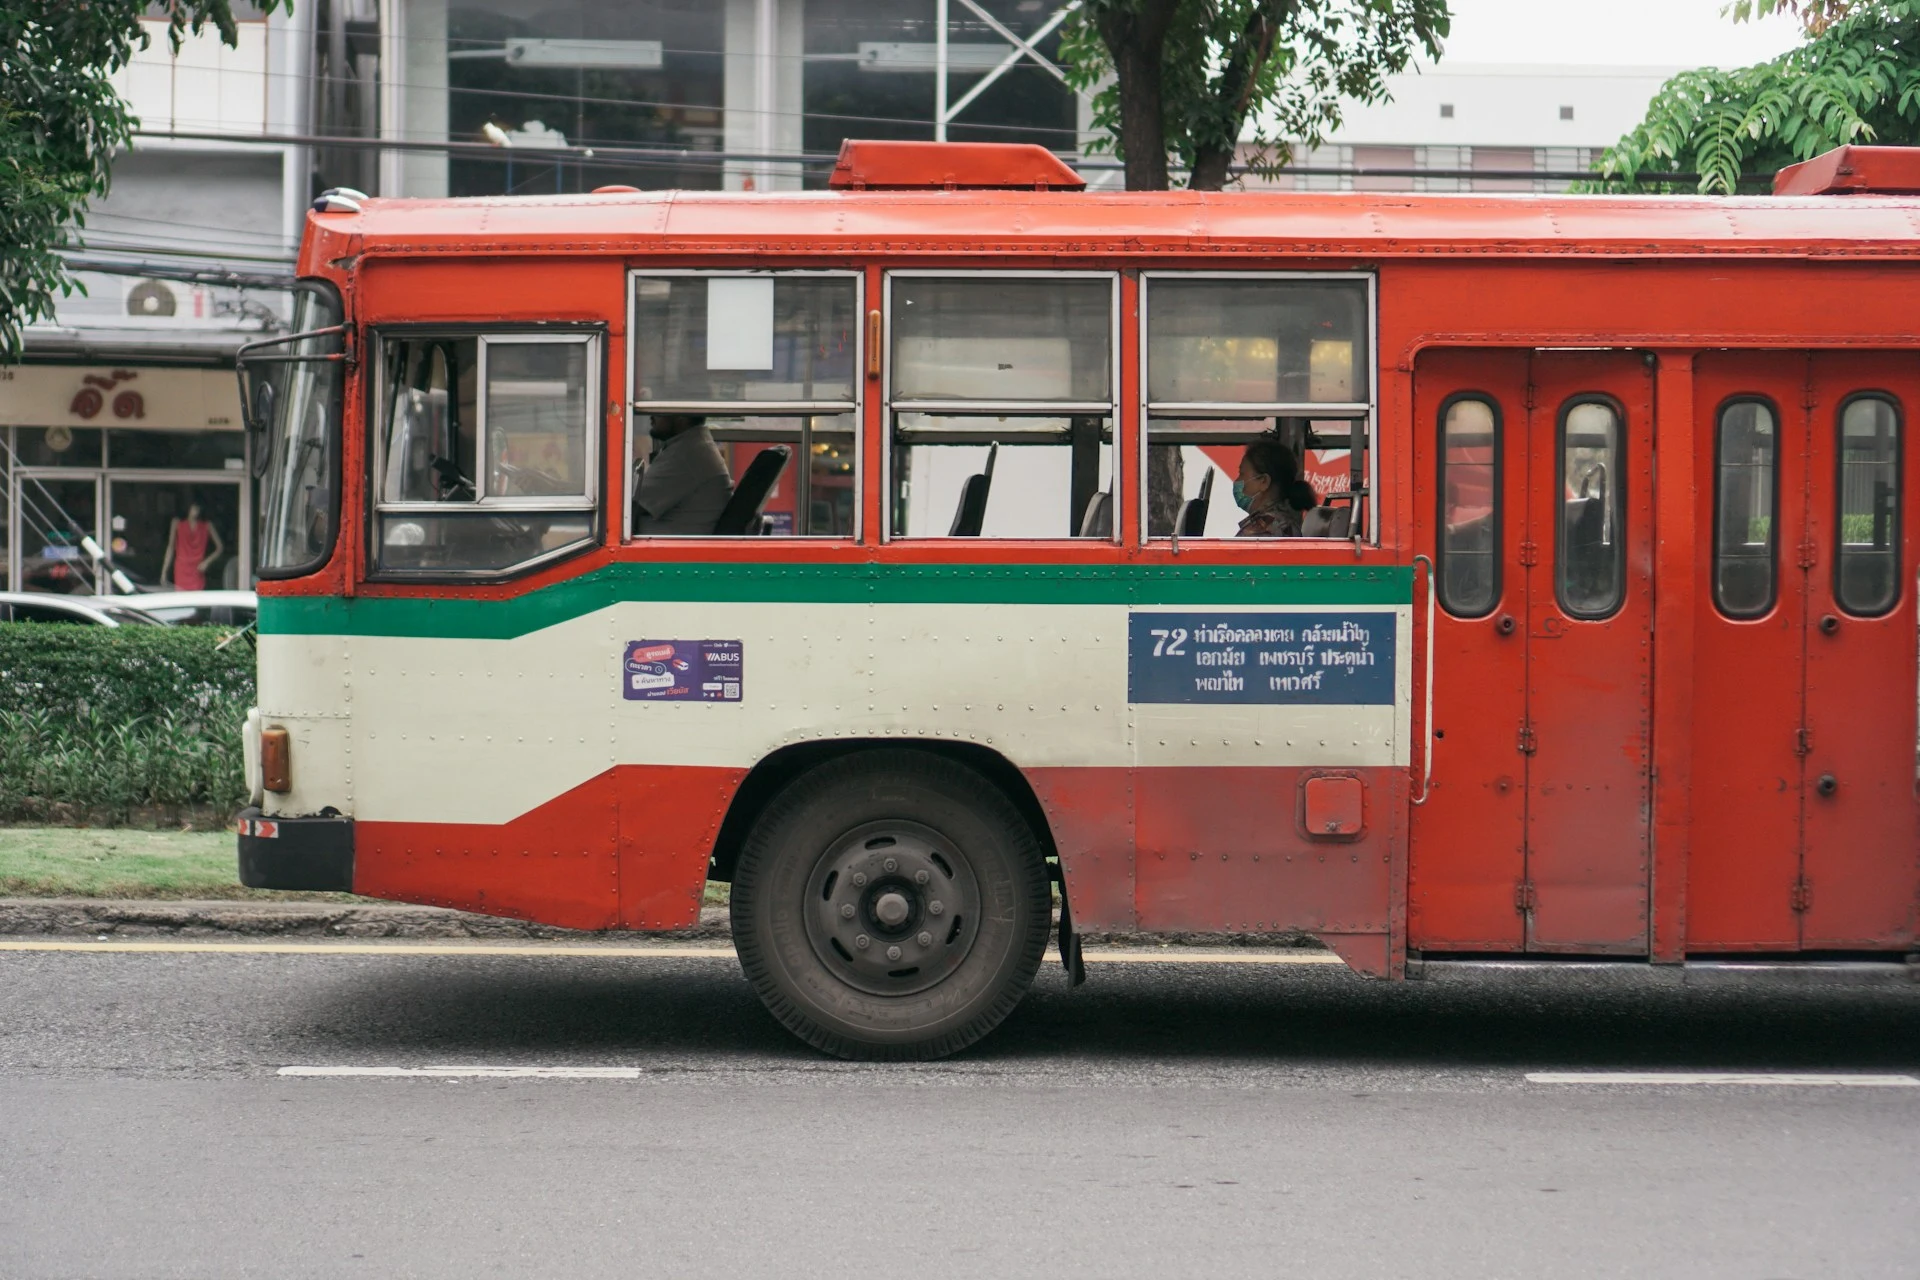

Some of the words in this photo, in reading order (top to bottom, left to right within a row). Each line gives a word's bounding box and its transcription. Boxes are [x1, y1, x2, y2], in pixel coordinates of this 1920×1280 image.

[1150, 628, 1188, 657] 72
[1193, 623, 1295, 643] ท่าเรือคลองเตย
[1196, 647, 1245, 666] เอกมัย
[1259, 646, 1314, 672] เพชรบุรี
[1320, 644, 1375, 674] ประตูน้ำ
[1195, 670, 1244, 691] พญาไท
[1270, 671, 1325, 691] เทเวศร์
